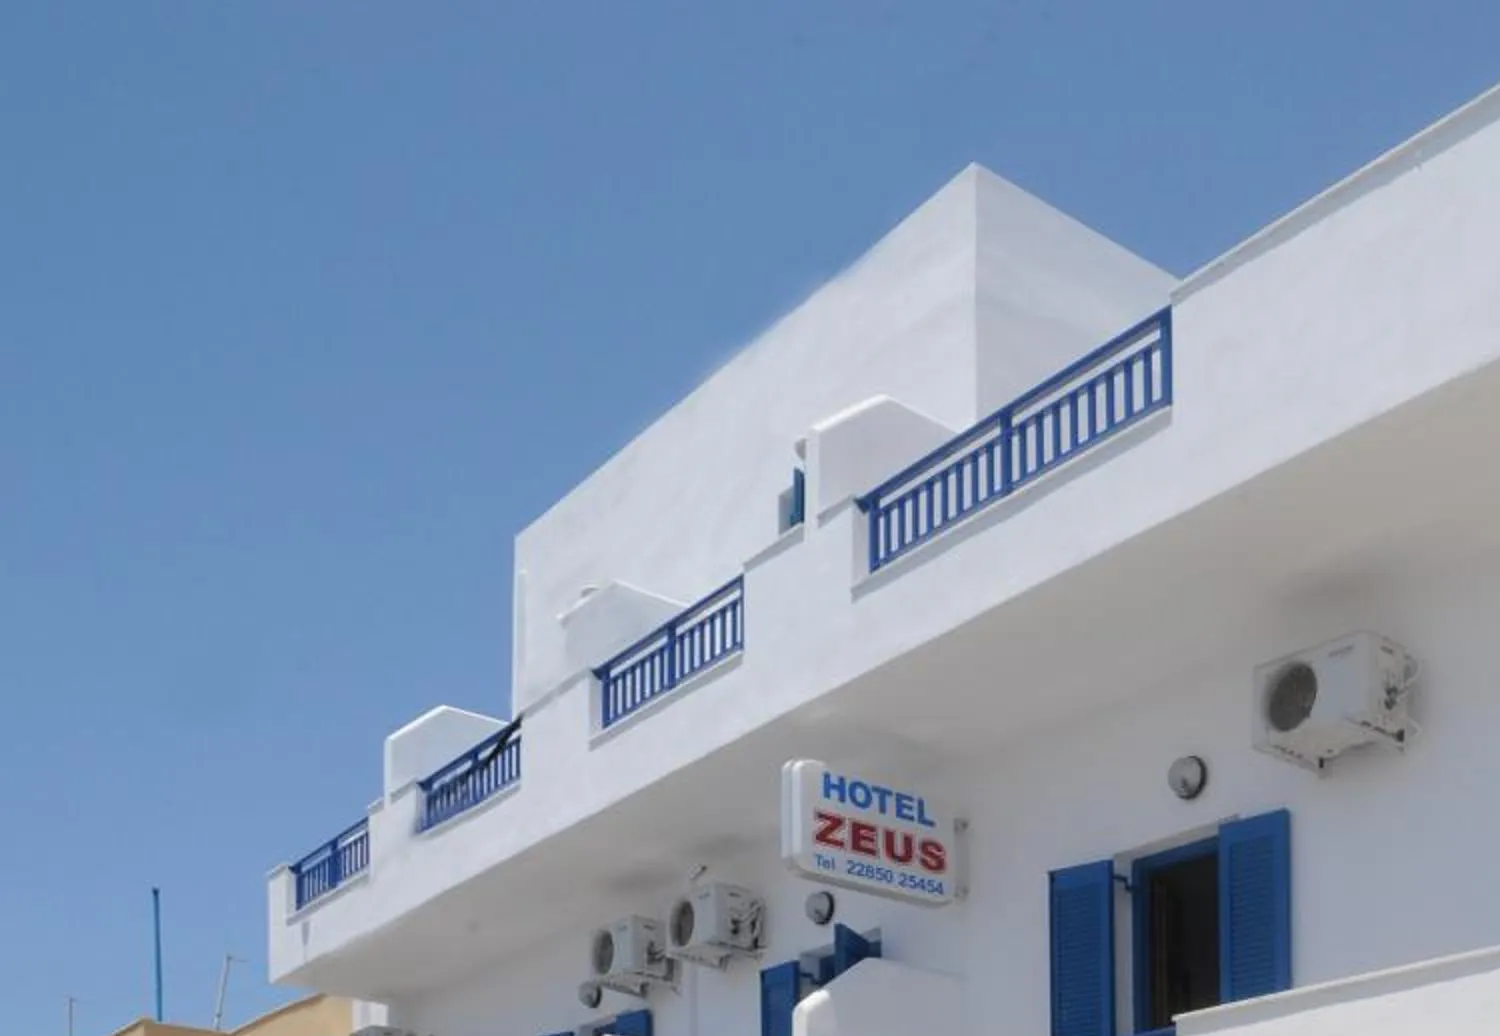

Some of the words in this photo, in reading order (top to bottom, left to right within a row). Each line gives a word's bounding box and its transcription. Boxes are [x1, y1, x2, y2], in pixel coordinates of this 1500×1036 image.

[823, 772, 936, 827] HOTEL
[815, 809, 947, 875] ZEUS
[847, 860, 894, 883] 22850
[898, 873, 945, 896] 25454
